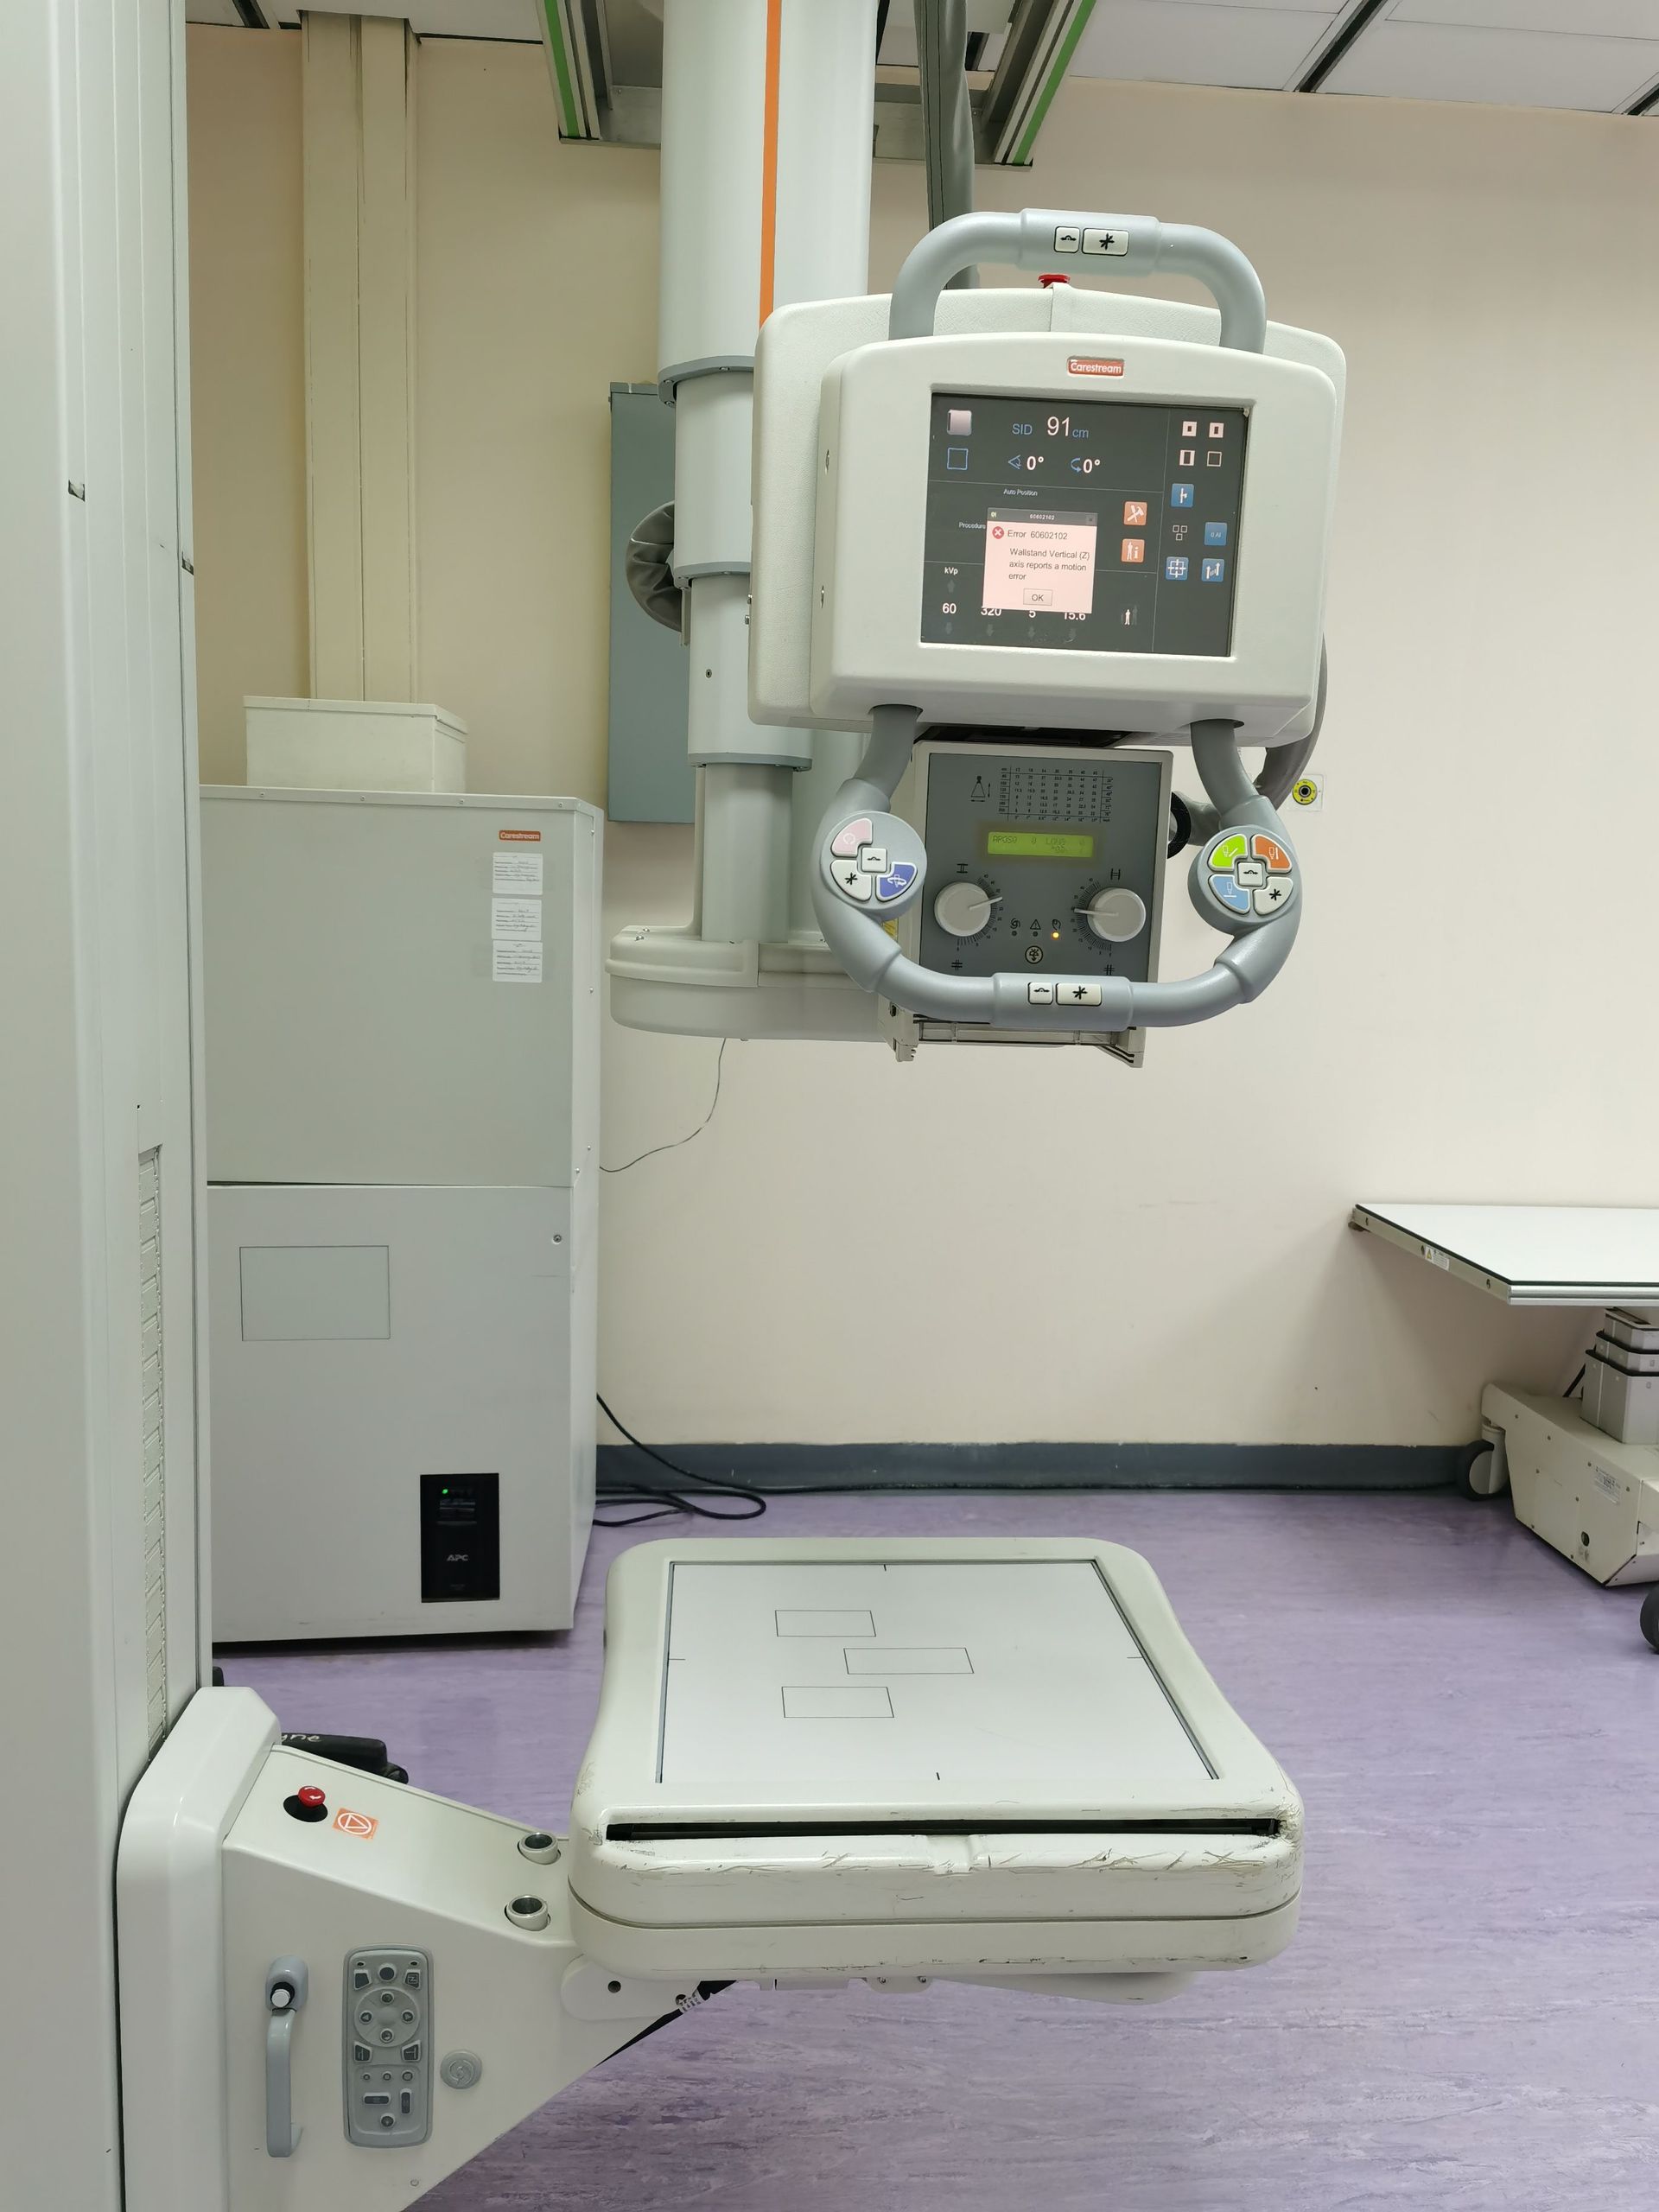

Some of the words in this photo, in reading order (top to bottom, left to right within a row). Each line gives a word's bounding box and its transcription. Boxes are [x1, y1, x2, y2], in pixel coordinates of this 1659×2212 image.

[1070, 362, 1122, 373] Carestream
[1012, 423, 1033, 435] SID
[1047, 416, 1071, 436] 91
[1072, 429, 1089, 438] cm
[1027, 455, 1045, 471] 0°
[1083, 459, 1101, 474] 0°
[1007, 530, 1027, 538] Error
[1030, 531, 1068, 540] 60602102
[1009, 548, 1047, 557] Wallstand
[1049, 550, 1077, 559] Vertical
[1078, 551, 1090, 561] (Z)
[944, 567, 958, 575] kVp
[1027, 562, 1052, 571] reports
[1061, 563, 1087, 572] motion
[1031, 594, 1045, 602] OK
[942, 603, 957, 614] 60
